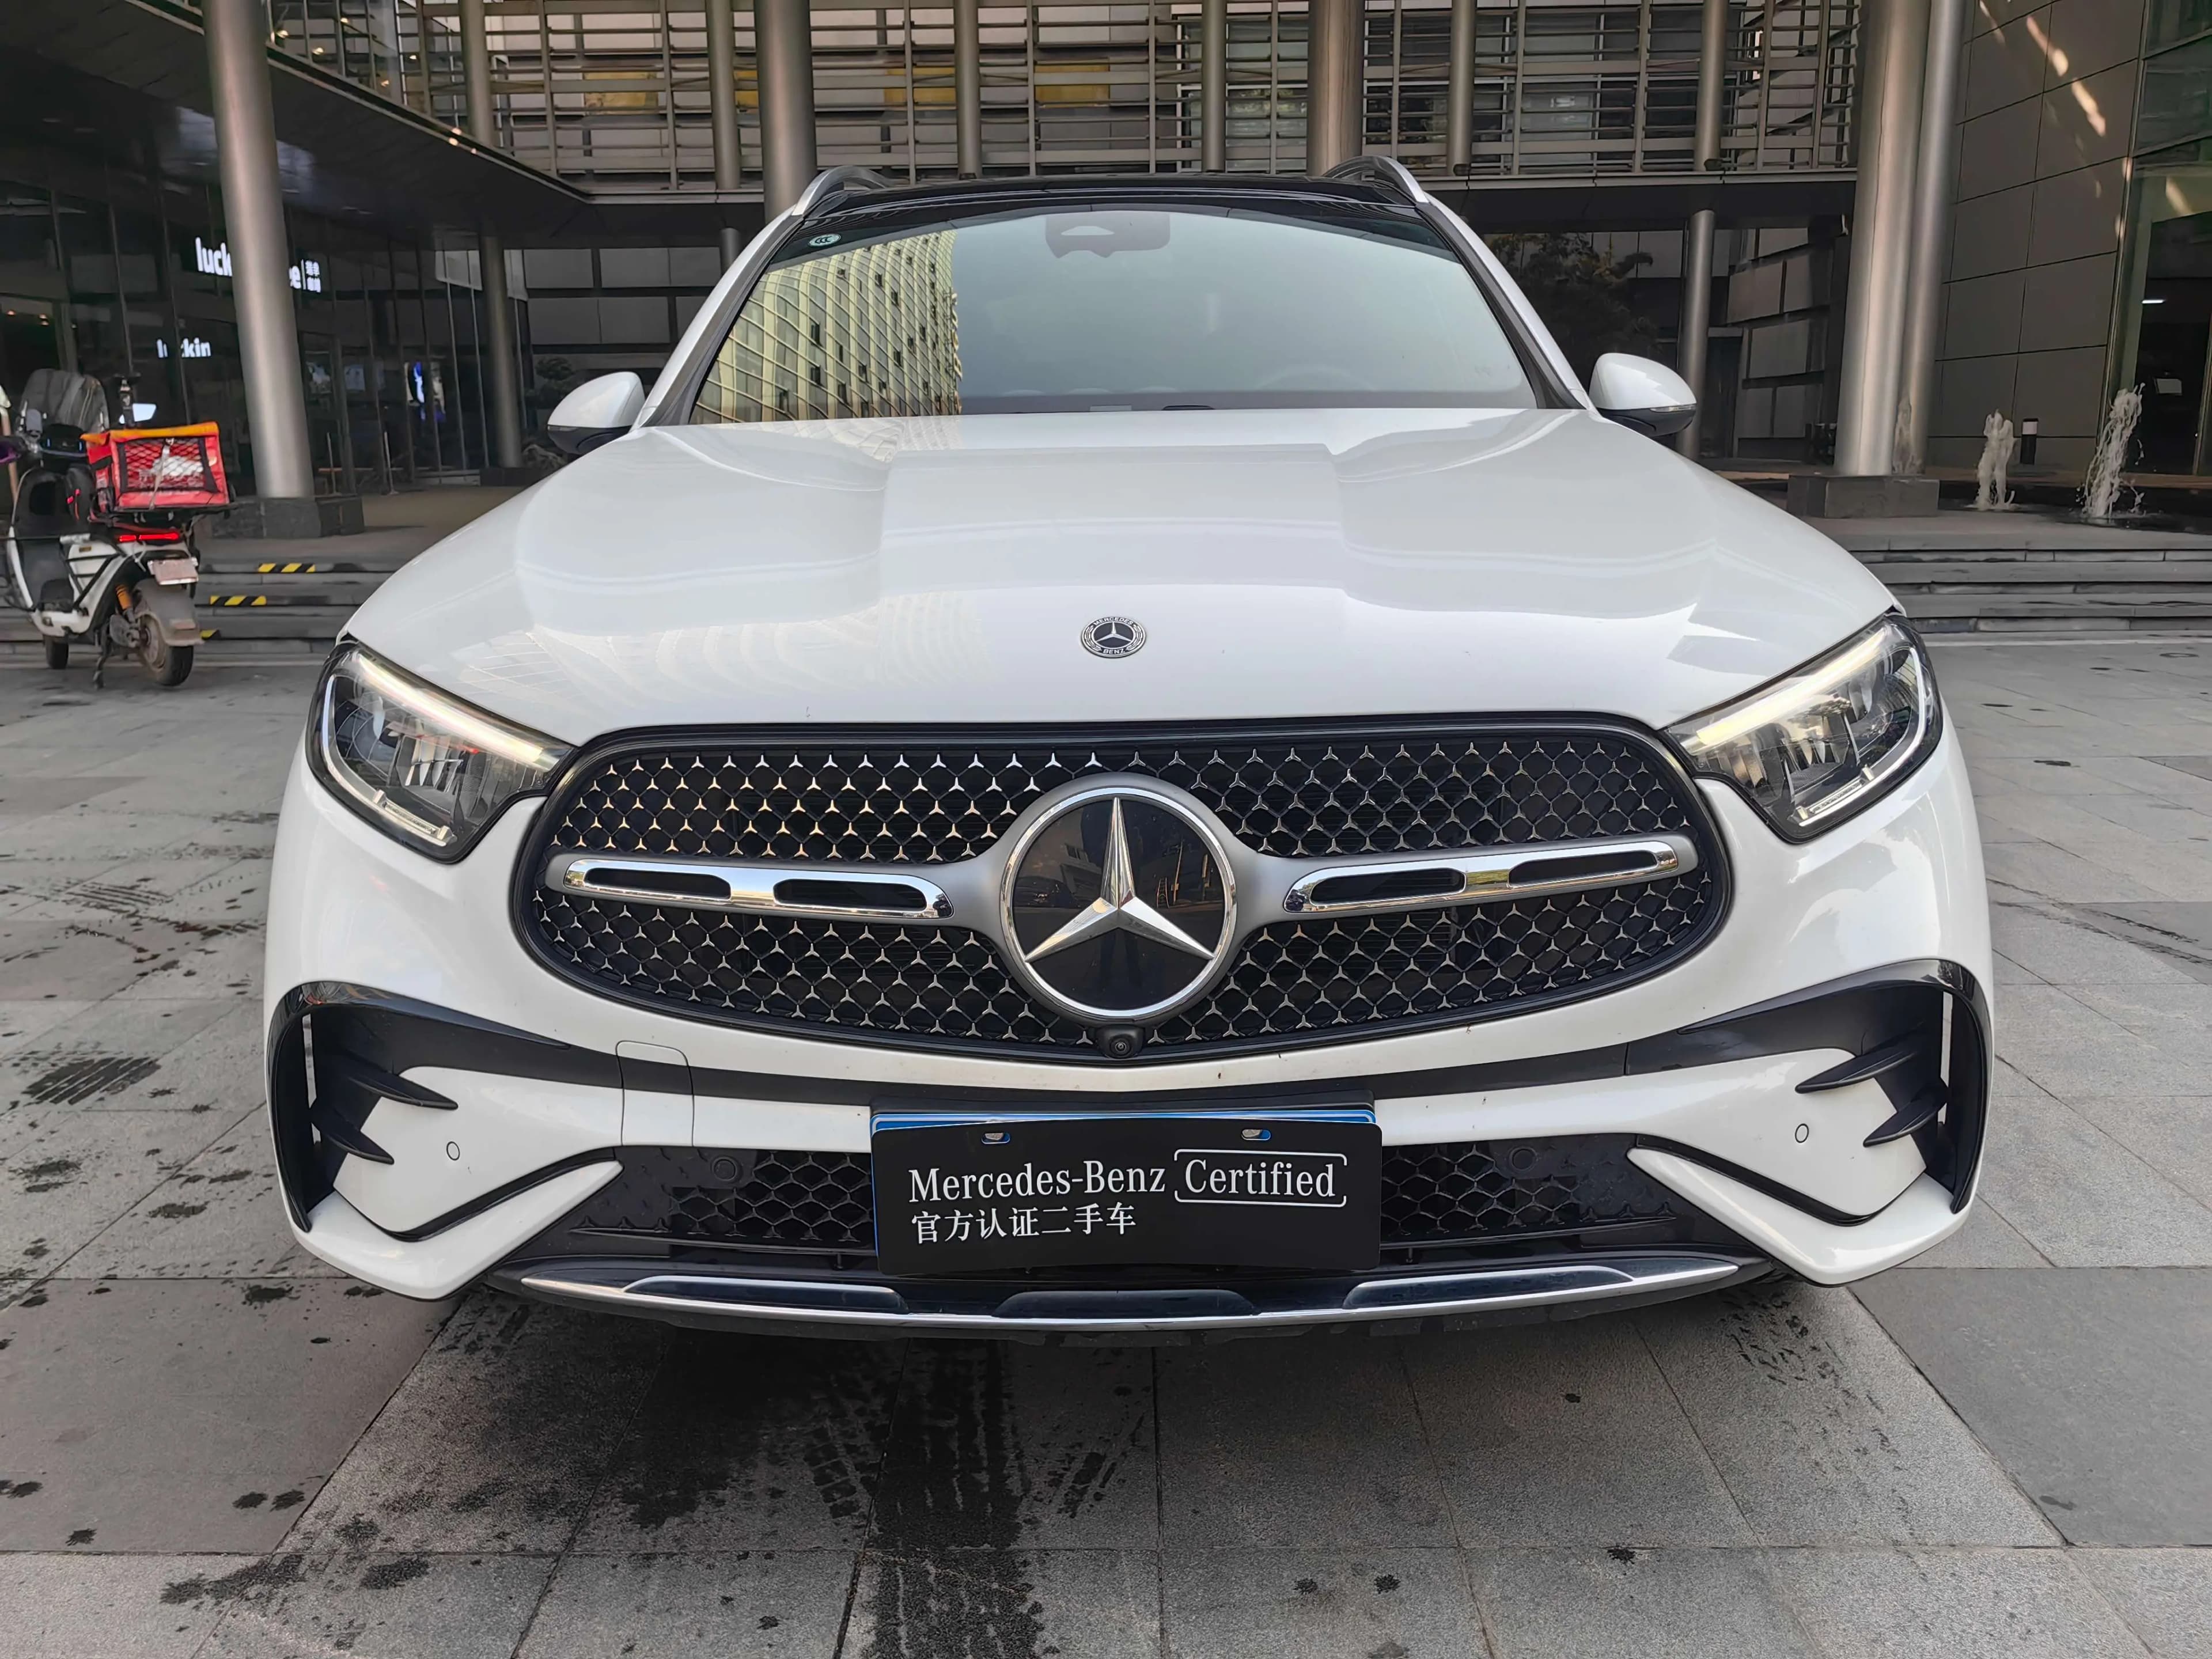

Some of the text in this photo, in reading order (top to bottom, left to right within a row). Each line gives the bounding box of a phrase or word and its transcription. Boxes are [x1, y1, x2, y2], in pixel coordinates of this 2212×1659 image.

[195, 237, 233, 276] luck
[1093, 617, 1134, 626] MERCEDES
[909, 1158, 1336, 1203] Mercedes-Benz Certified
[911, 1202, 1137, 1244] 官方认证二手车
